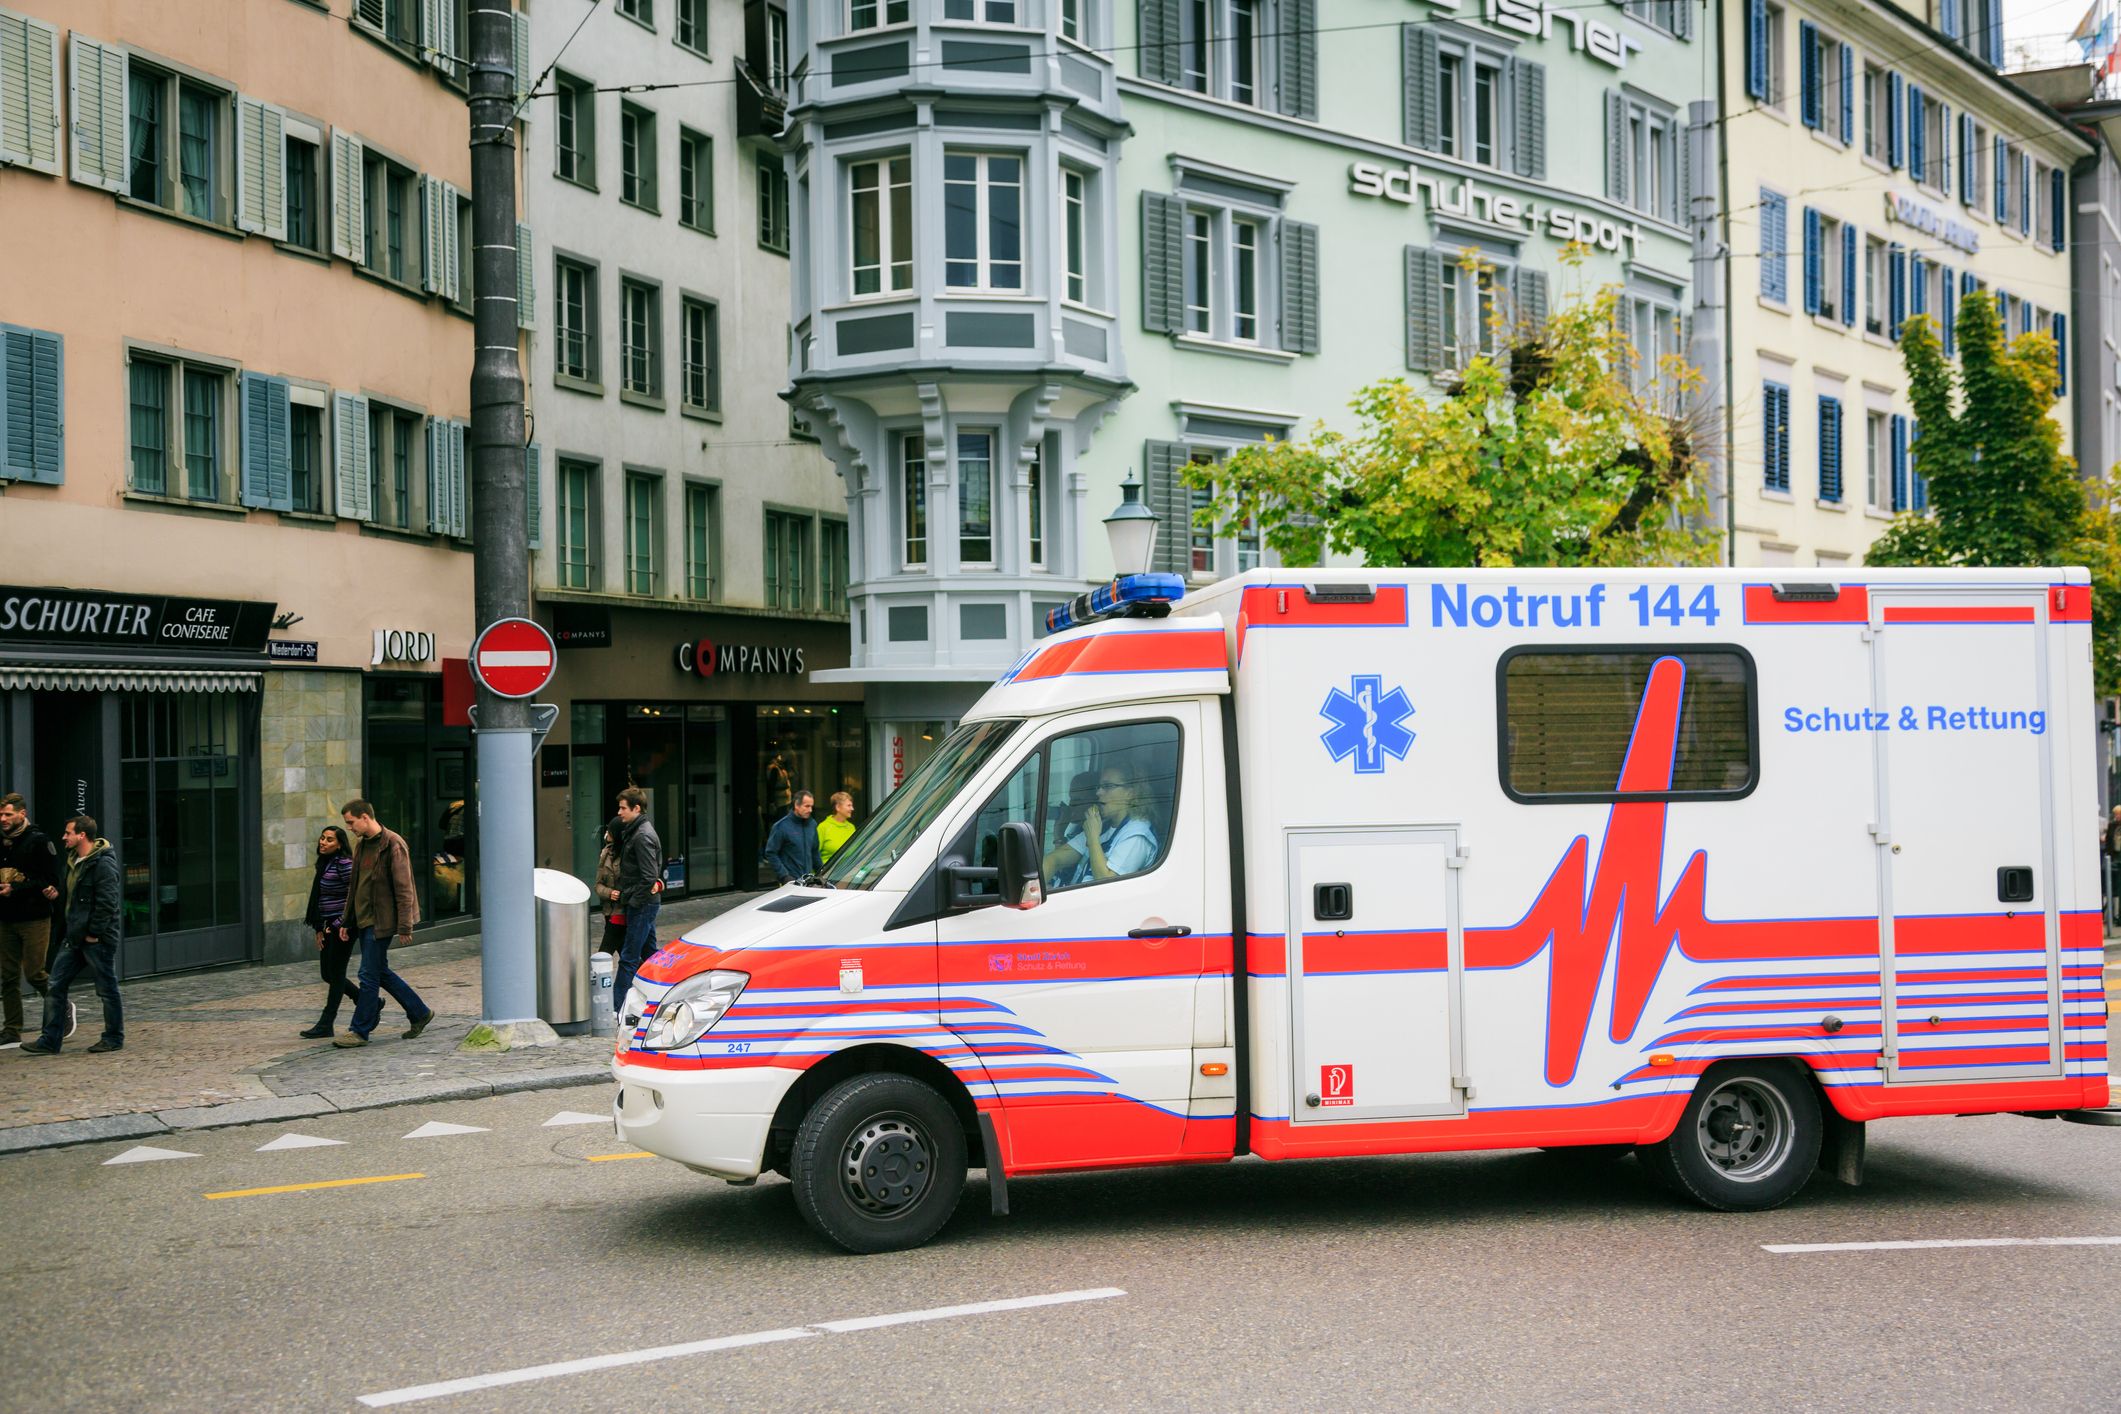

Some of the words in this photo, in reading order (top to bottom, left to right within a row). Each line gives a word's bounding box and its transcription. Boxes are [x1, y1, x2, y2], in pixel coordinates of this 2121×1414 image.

[0, 597, 151, 635] SCHURTER
[186, 607, 216, 623] CAFE
[1431, 583, 1605, 627] Notruf
[1629, 584, 1720, 626] 144
[162, 623, 230, 640] CONFISERIE
[371, 629, 435, 665] JORDI
[556, 630, 606, 639] COMPANYS
[679, 638, 805, 677] COMPANYS
[1784, 706, 1889, 733] Schutz
[1899, 707, 1919, 731] &
[1927, 704, 2046, 734] Rettung
[893, 736, 904, 788] HOES
[728, 1043, 751, 1053] 247
